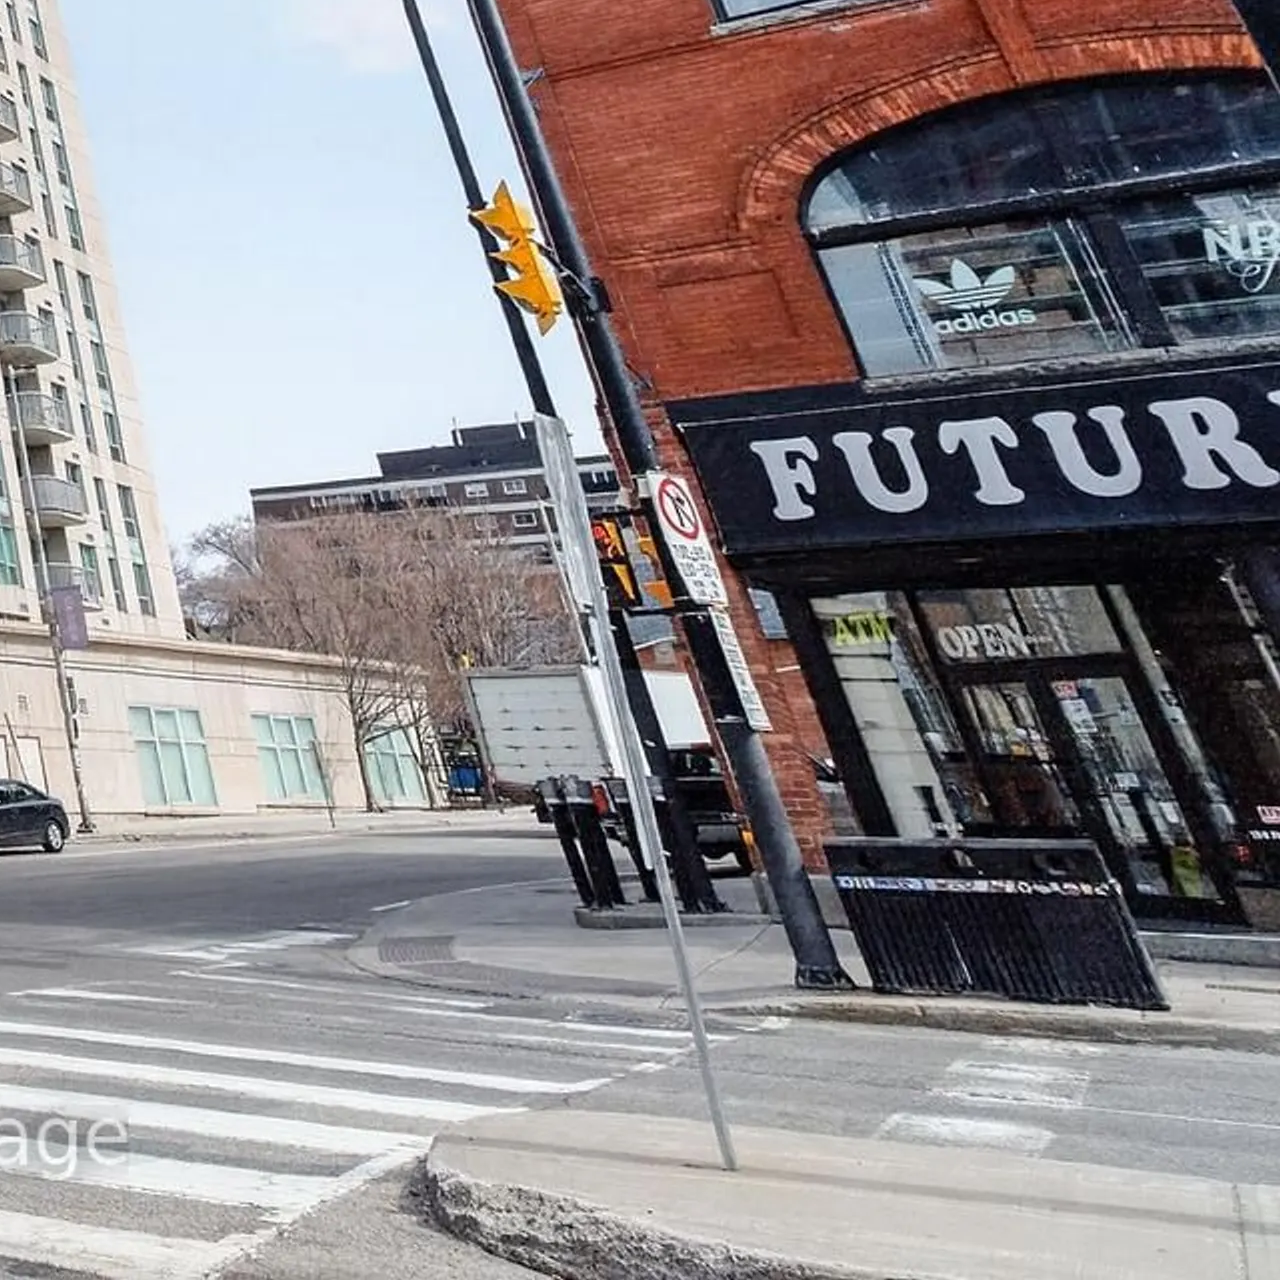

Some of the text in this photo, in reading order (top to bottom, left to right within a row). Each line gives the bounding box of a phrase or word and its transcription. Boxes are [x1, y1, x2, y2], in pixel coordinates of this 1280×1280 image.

[936, 306, 1037, 334] adidas
[750, 391, 1280, 521] FUTUR
[834, 612, 892, 646] ATM
[938, 616, 1033, 660] OPEN
